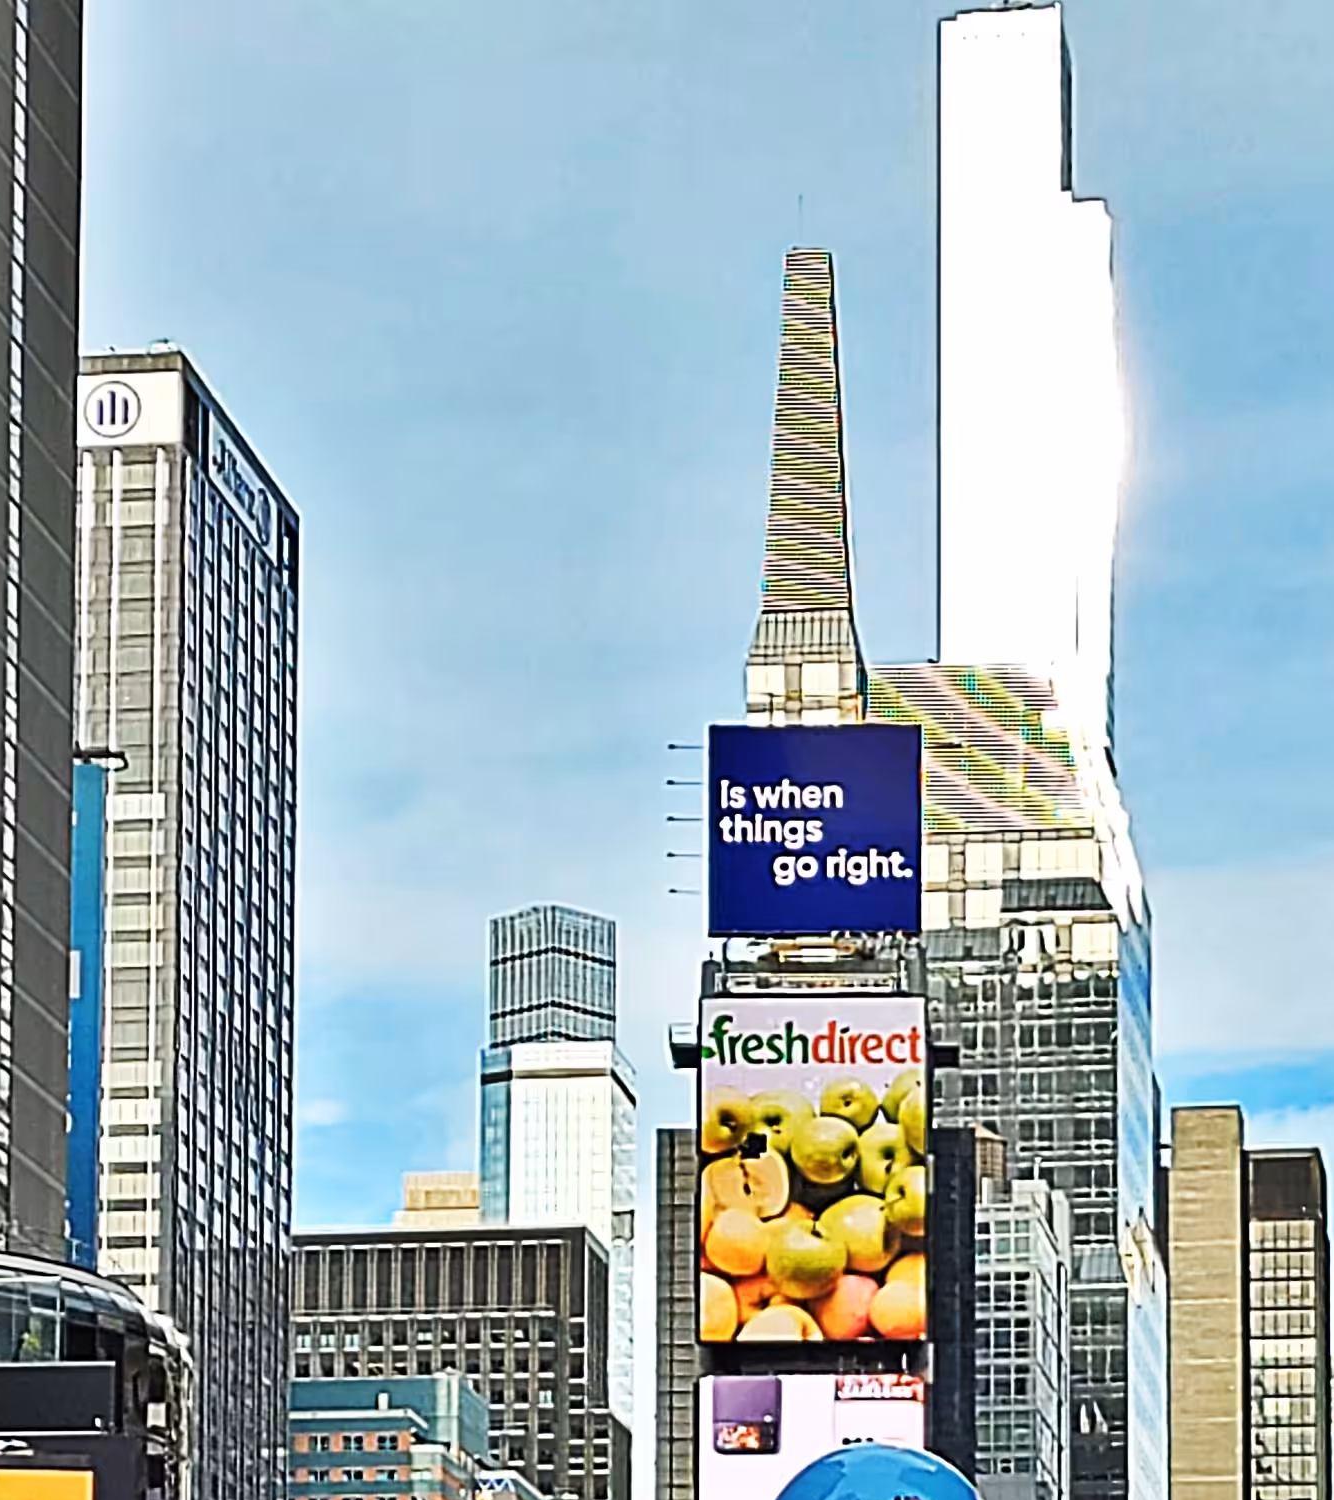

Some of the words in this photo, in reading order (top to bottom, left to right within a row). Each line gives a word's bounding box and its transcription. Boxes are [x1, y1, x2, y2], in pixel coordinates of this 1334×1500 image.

[720, 779, 747, 808] Is
[753, 779, 844, 809] when
[720, 813, 823, 849] things
[773, 855, 818, 886] go
[826, 848, 914, 886] right.
[709, 1014, 922, 1066] freshdirect
